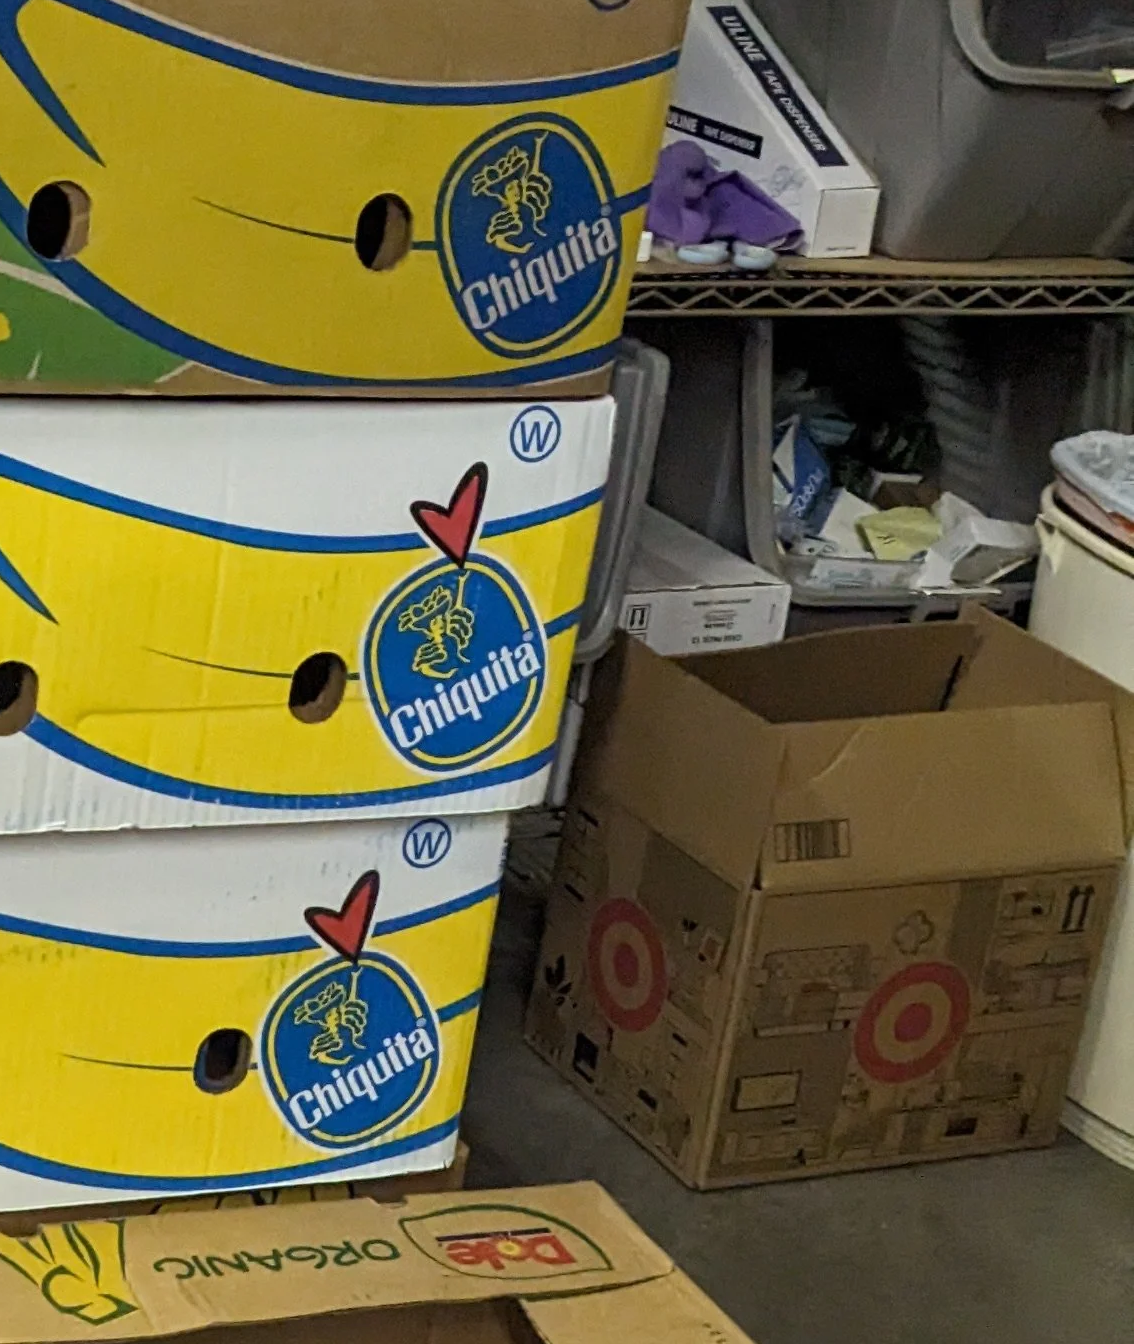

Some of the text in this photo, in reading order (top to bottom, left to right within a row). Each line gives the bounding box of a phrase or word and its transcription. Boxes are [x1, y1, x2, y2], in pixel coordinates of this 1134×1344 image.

[721, 15, 828, 153] ULINE TAPE DISPENSER
[462, 215, 618, 331] Chiquita
[519, 419, 554, 453] W
[390, 641, 542, 749] Chiquita
[412, 830, 446, 860] W
[289, 1026, 436, 1131] Chiquita
[154, 1238, 400, 1280] ORGANIC
[446, 1233, 577, 1271] Dole
